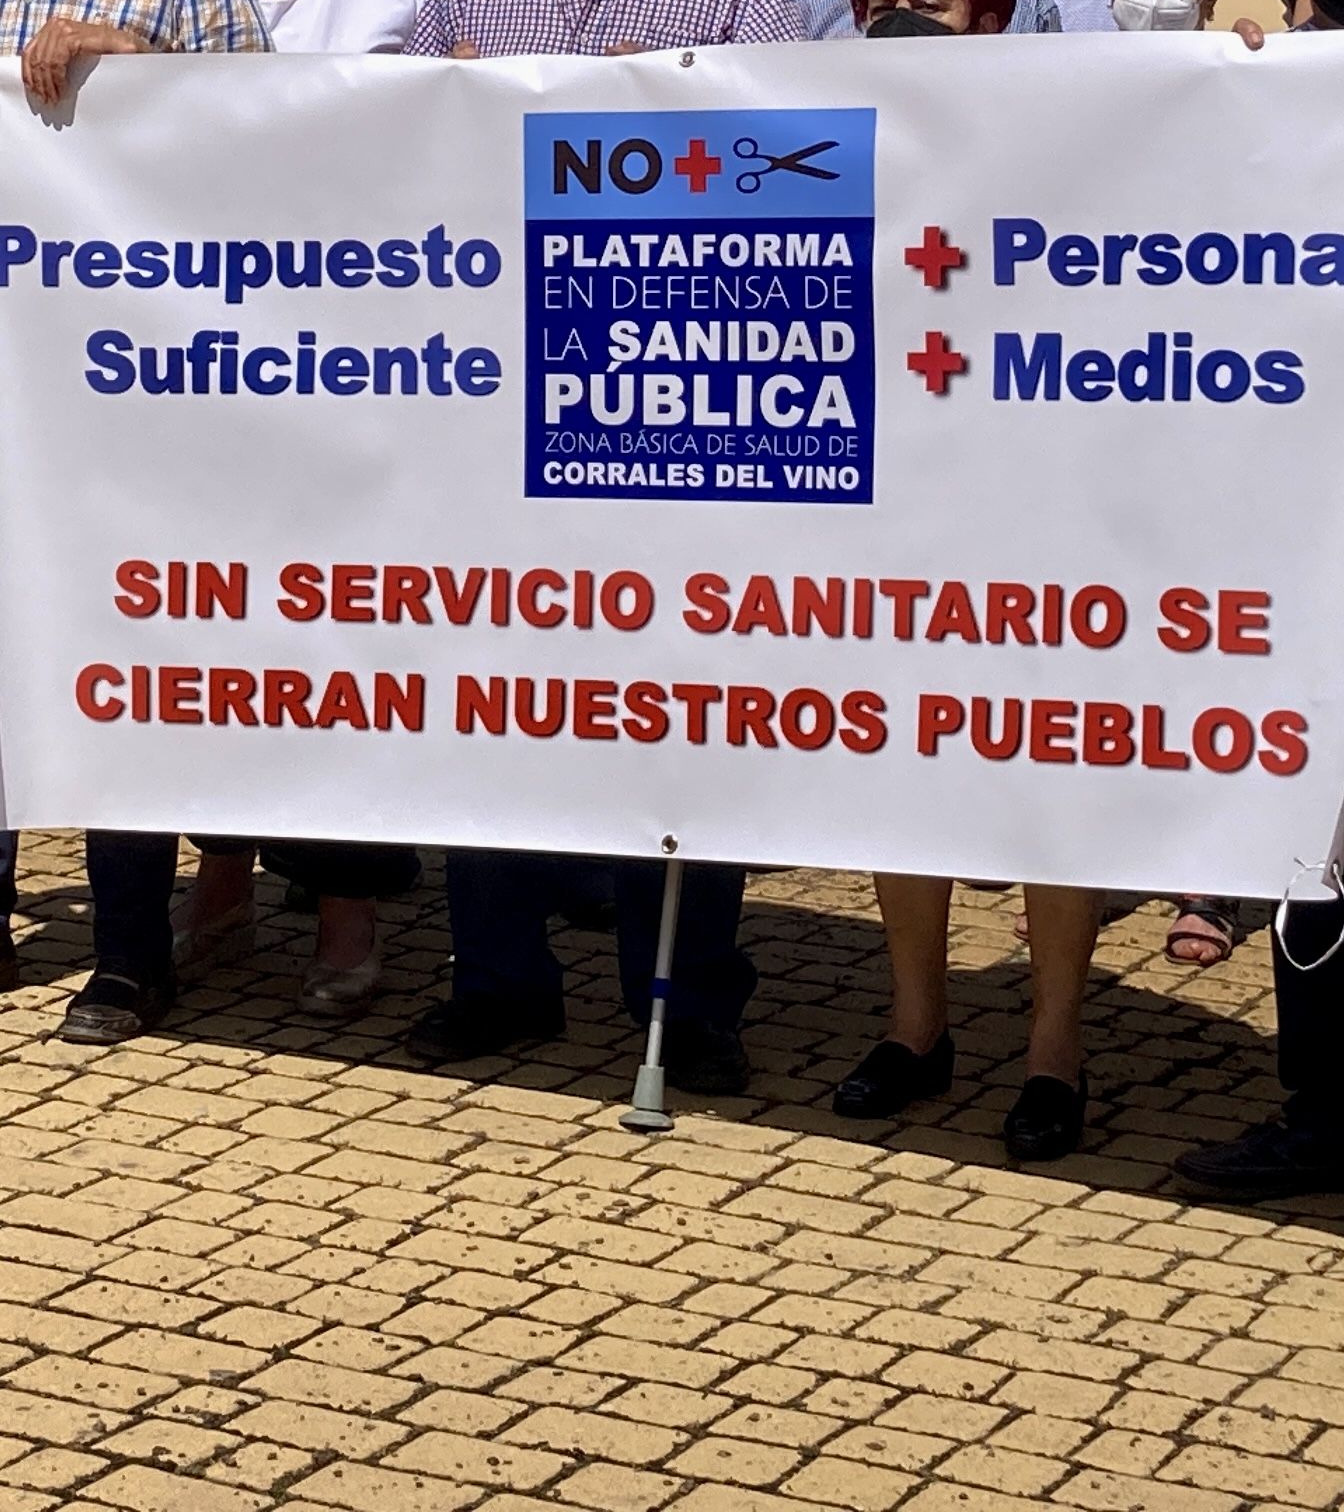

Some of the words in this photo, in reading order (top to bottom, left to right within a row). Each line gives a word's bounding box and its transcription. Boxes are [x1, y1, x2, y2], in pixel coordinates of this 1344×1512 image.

[543, 233, 853, 268] PLATAFORMA
[544, 276, 593, 309] EN
[612, 276, 790, 309] DEFENSA
[804, 276, 853, 309] DE
[84, 330, 502, 396] Suficiente
[544, 327, 588, 361] LA
[607, 320, 855, 363] SANIDAD
[993, 332, 1306, 404] Medios
[545, 361, 857, 429] PÚBLICA
[545, 431, 612, 454] ZONA
[620, 429, 699, 455] BÁSICA
[706, 433, 736, 455] DE
[744, 434, 820, 457] SALUD
[828, 435, 859, 458] DE
[543, 461, 705, 488] CORRALES
[716, 464, 773, 489] DEL
[784, 465, 860, 490] VINO
[113, 559, 247, 620] SIN
[277, 562, 655, 632] SERVICIO
[683, 571, 1127, 650] SANITARIO
[1157, 587, 1272, 657] SE
[75, 663, 426, 732] CIERRAN
[456, 674, 889, 754] NUESTROS
[917, 693, 1310, 778] PUEBLOS
